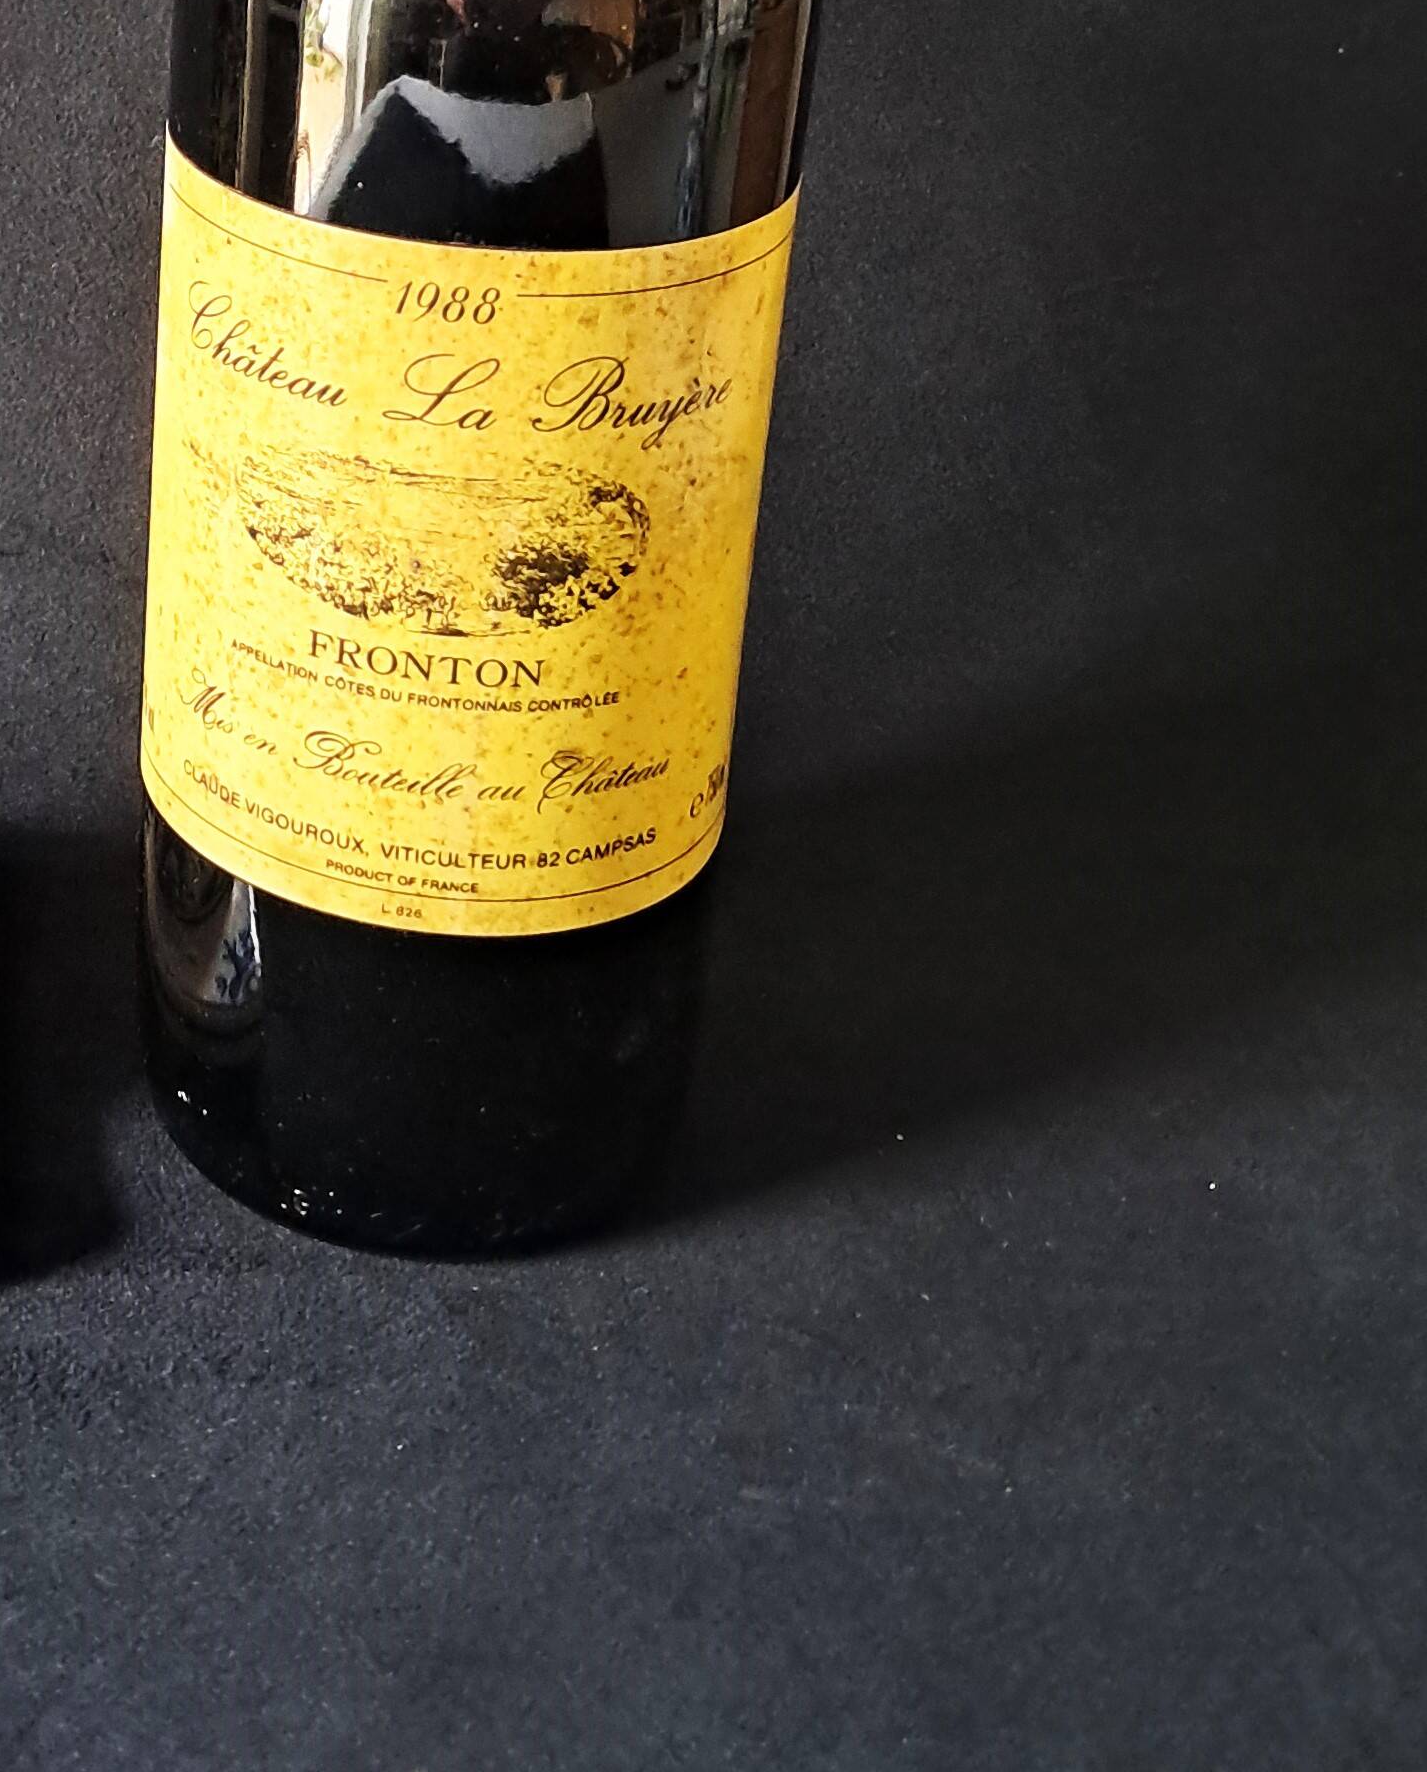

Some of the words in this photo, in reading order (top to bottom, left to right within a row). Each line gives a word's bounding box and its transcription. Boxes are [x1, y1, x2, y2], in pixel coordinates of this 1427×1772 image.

[396, 280, 501, 326] 1988
[188, 280, 348, 406] Château
[382, 353, 501, 431] La
[530, 356, 733, 450] Bruyère
[231, 639, 318, 682] APPELLATION
[325, 675, 375, 698] CÔTES
[380, 688, 402, 703] DU
[407, 693, 522, 712] FRONTONNAIS
[308, 629, 546, 689] FRONTON
[180, 668, 233, 734] Mis
[243, 732, 278, 756] en
[293, 730, 477, 805] Bouteille
[477, 784, 526, 801] au
[537, 750, 669, 814] Château
[183, 759, 240, 809] CLAUDE
[245, 797, 369, 857] VIGOUROUX,
[380, 842, 526, 870] VITICULTEUR
[536, 851, 560, 868] 82
[565, 827, 656, 865] CAMPSAS
[326, 859, 393, 884] PRODUCT
[397, 876, 417, 887] OF
[421, 878, 479, 894] FRANCE
[380, 903, 391, 915] L
